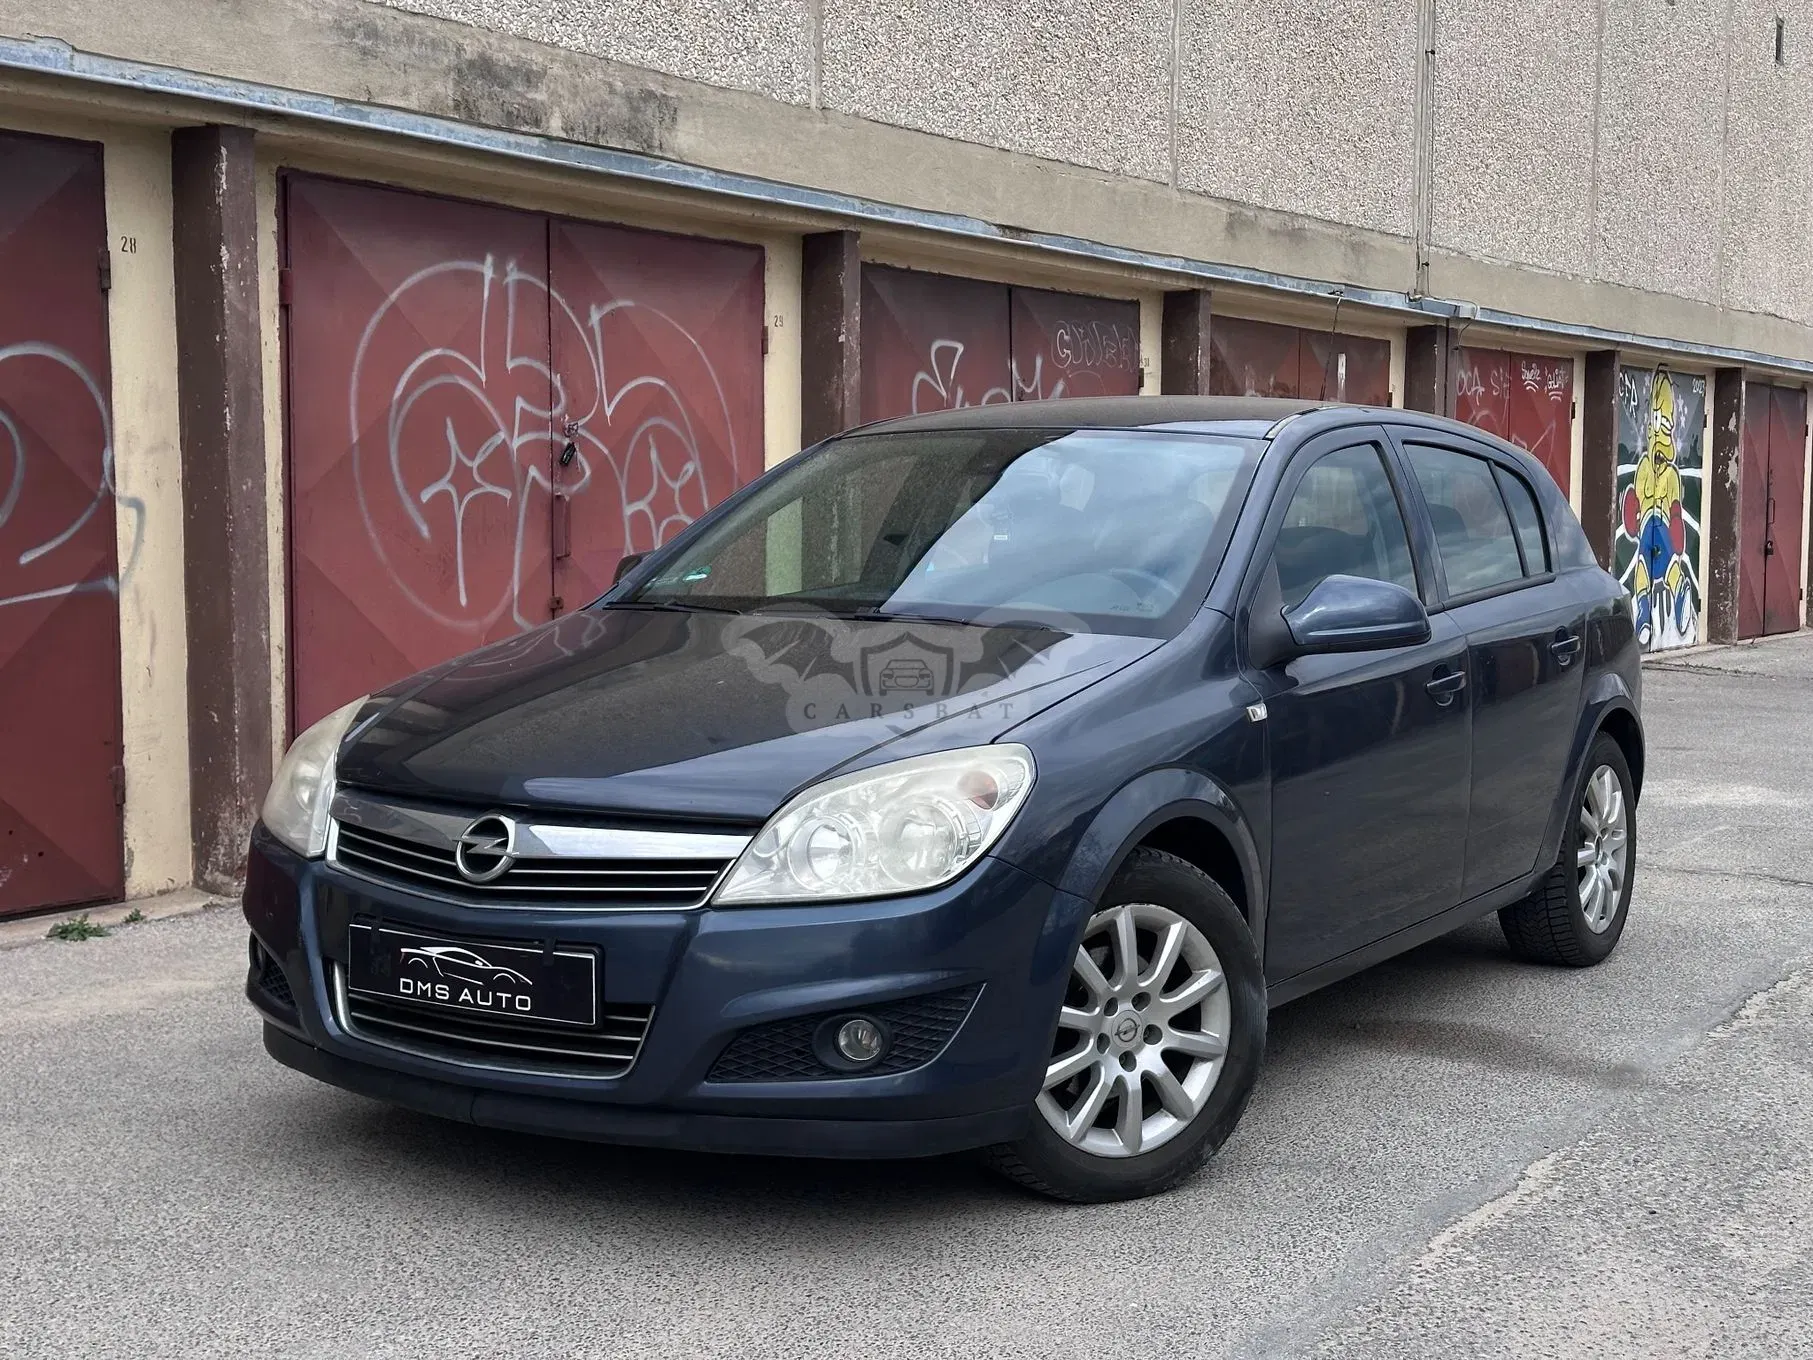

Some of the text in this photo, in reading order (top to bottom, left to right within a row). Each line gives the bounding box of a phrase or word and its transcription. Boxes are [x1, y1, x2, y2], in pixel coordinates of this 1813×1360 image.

[120, 235, 137, 254] 28
[400, 978, 532, 1012] DMS AUTO
